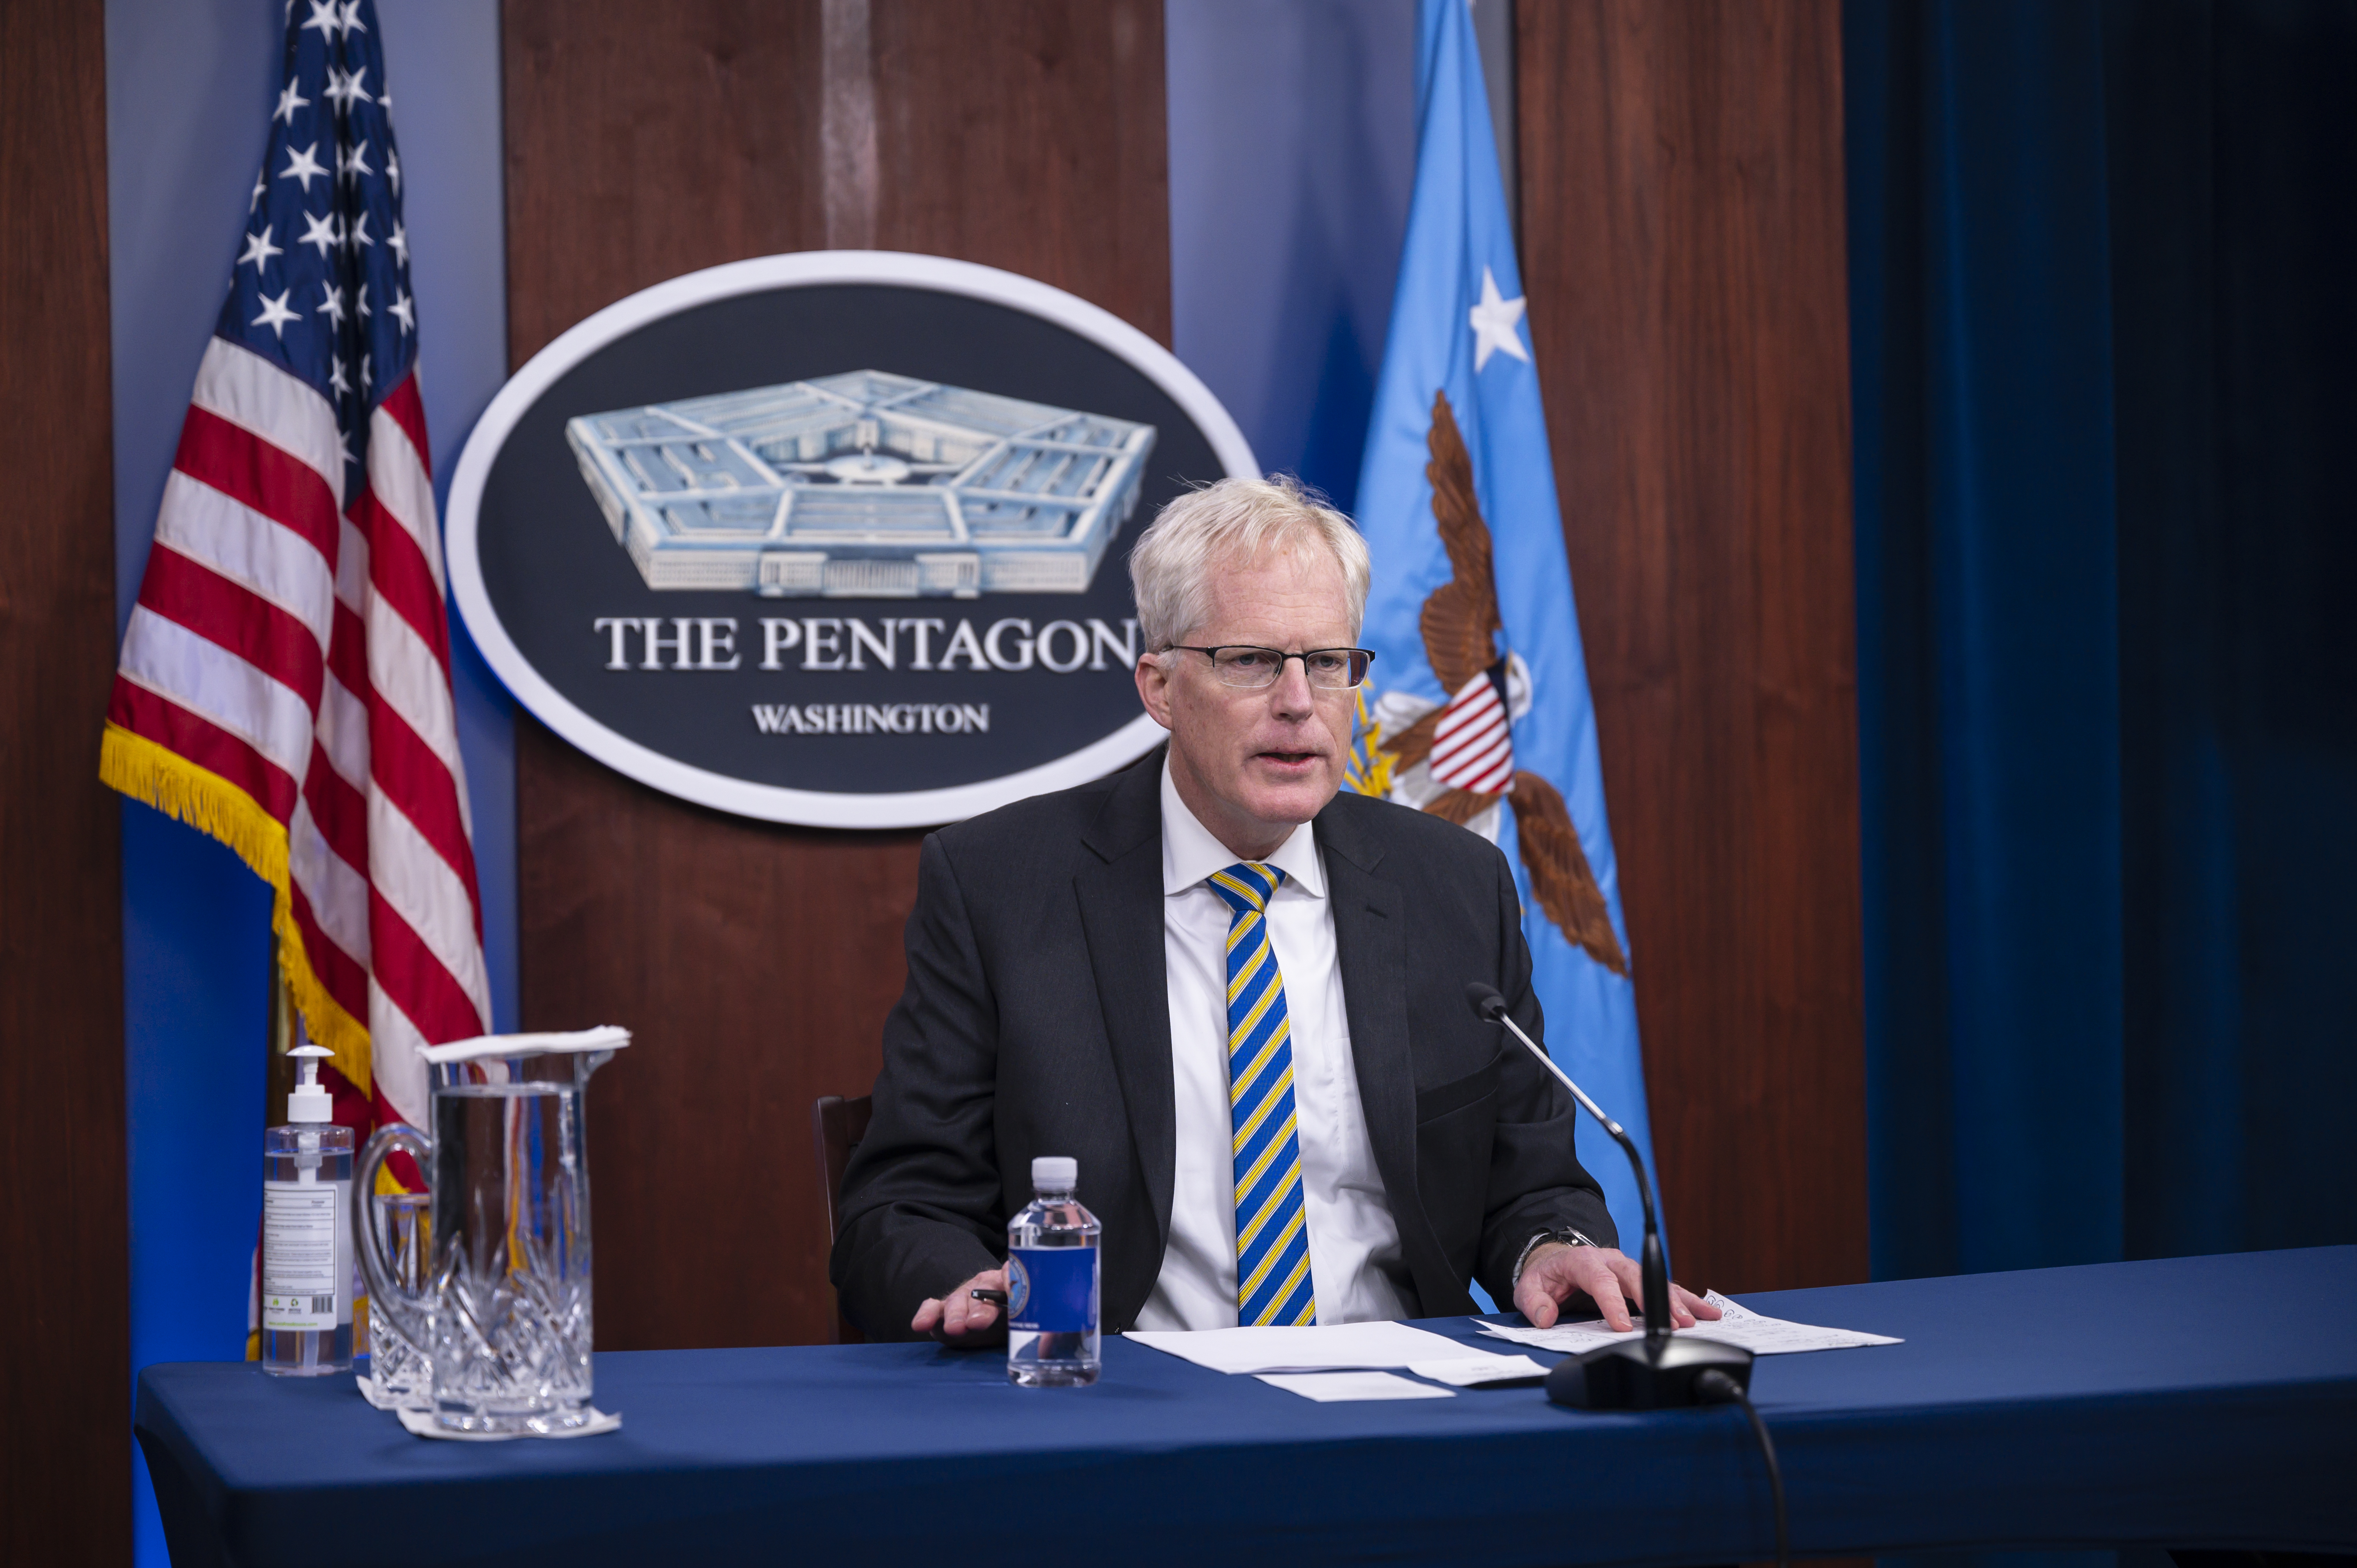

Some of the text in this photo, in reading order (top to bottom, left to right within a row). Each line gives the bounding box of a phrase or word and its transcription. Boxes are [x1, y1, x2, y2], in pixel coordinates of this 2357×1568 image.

[594, 618, 1138, 672] THE PENTAGON
[753, 705, 988, 733] WASHINGTON
